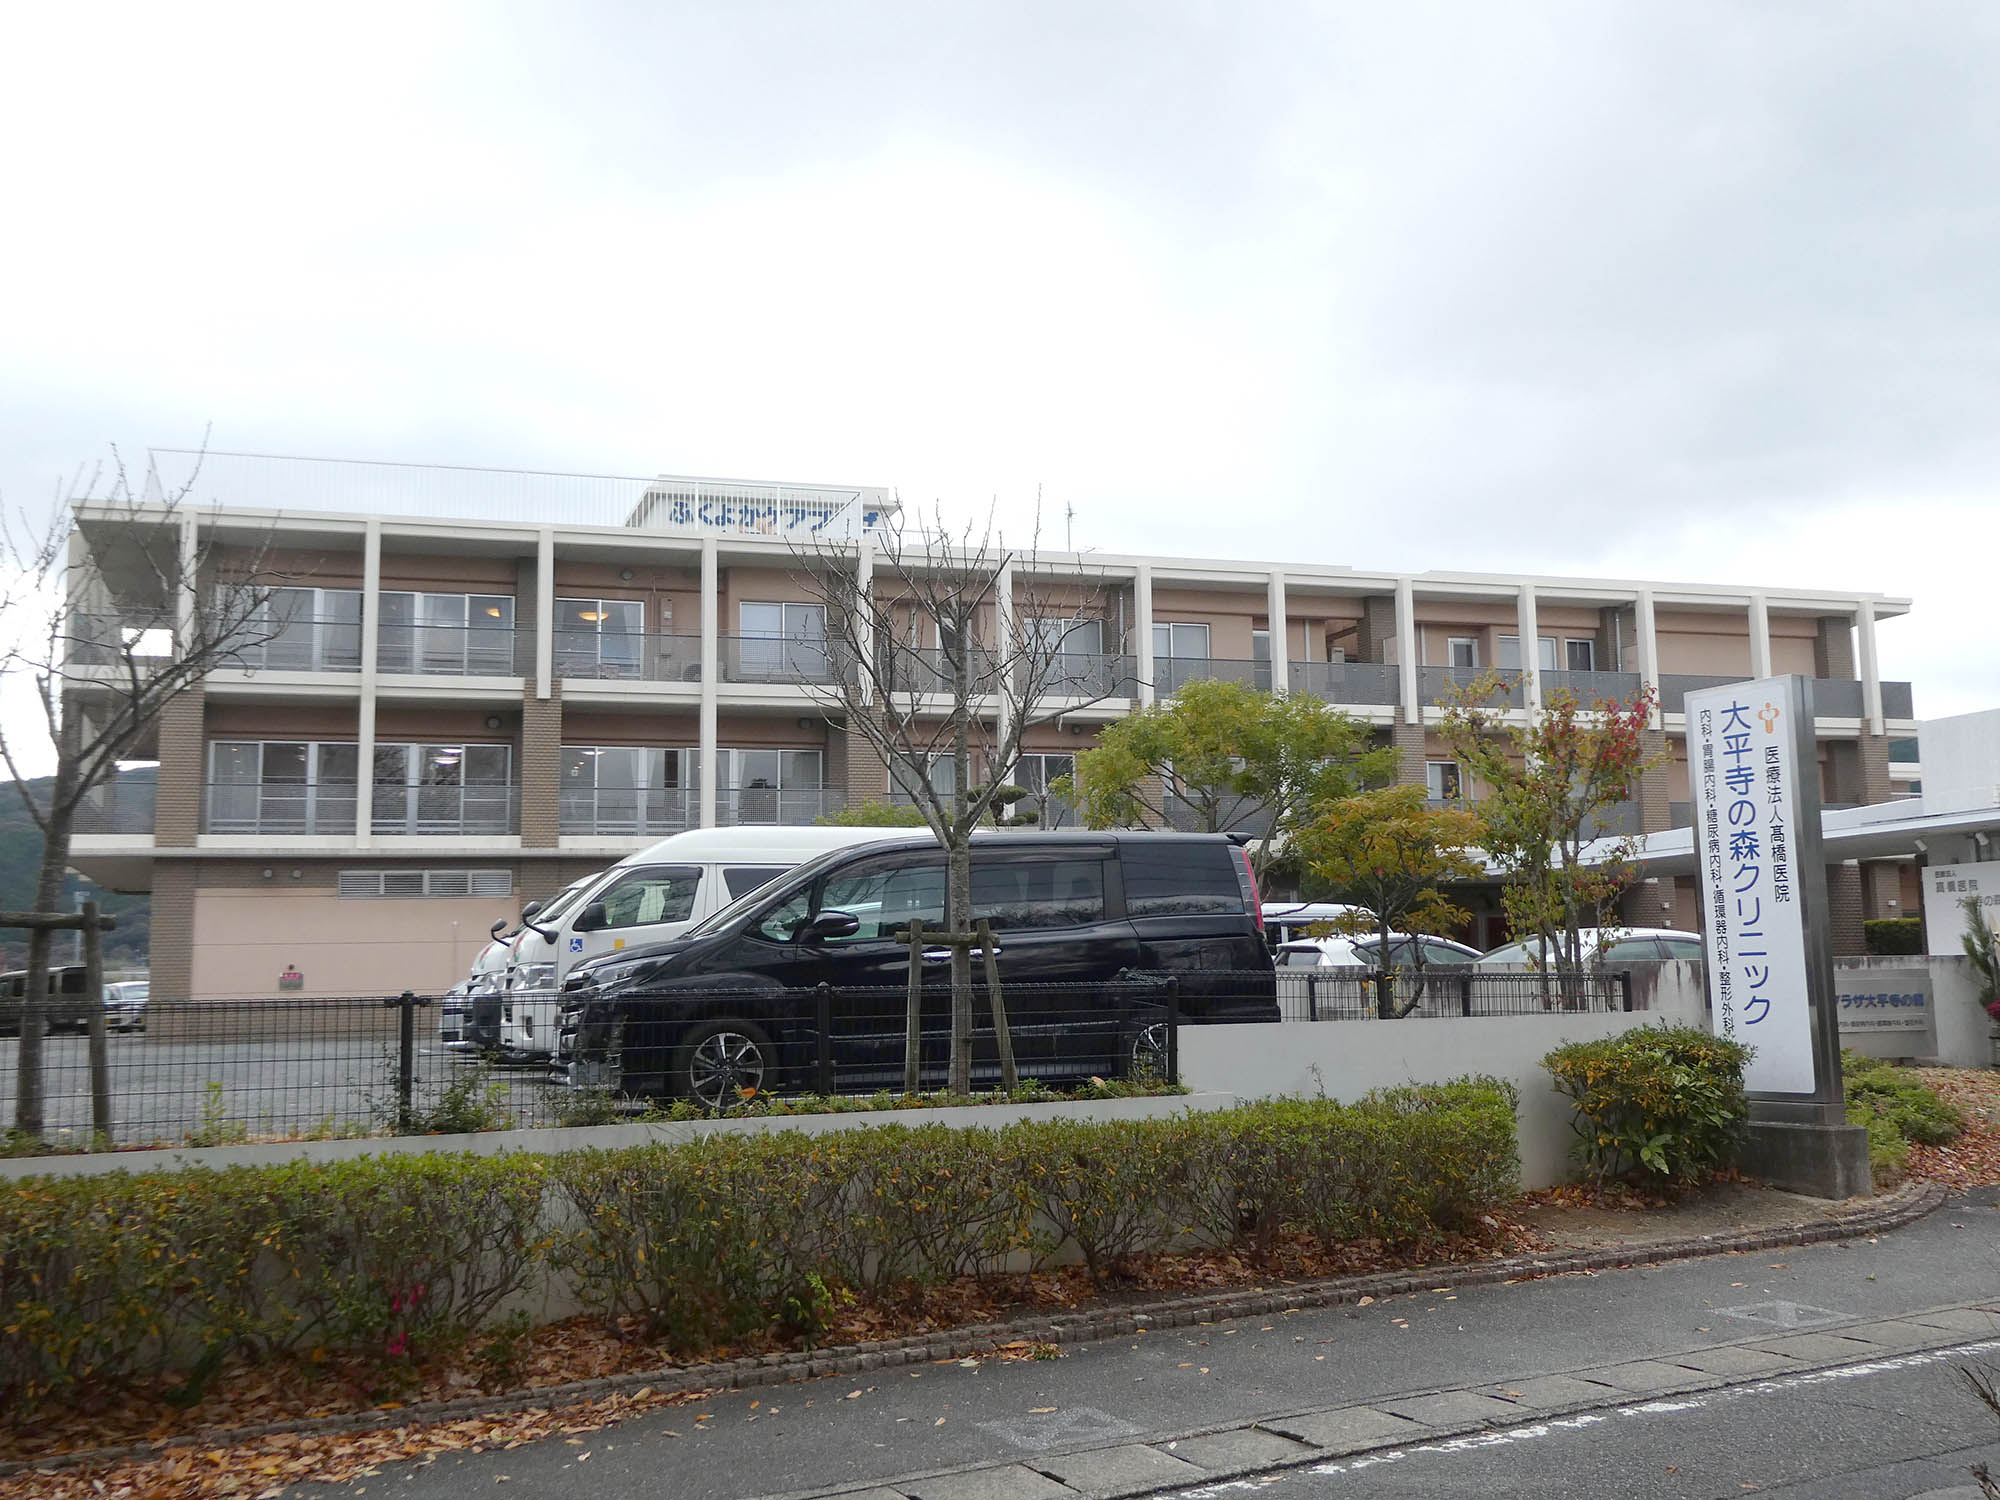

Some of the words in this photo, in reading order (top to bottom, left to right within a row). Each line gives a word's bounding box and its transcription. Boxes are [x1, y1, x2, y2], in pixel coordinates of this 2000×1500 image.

[1720, 700, 1771, 1025] 大平寺の森クリニック
